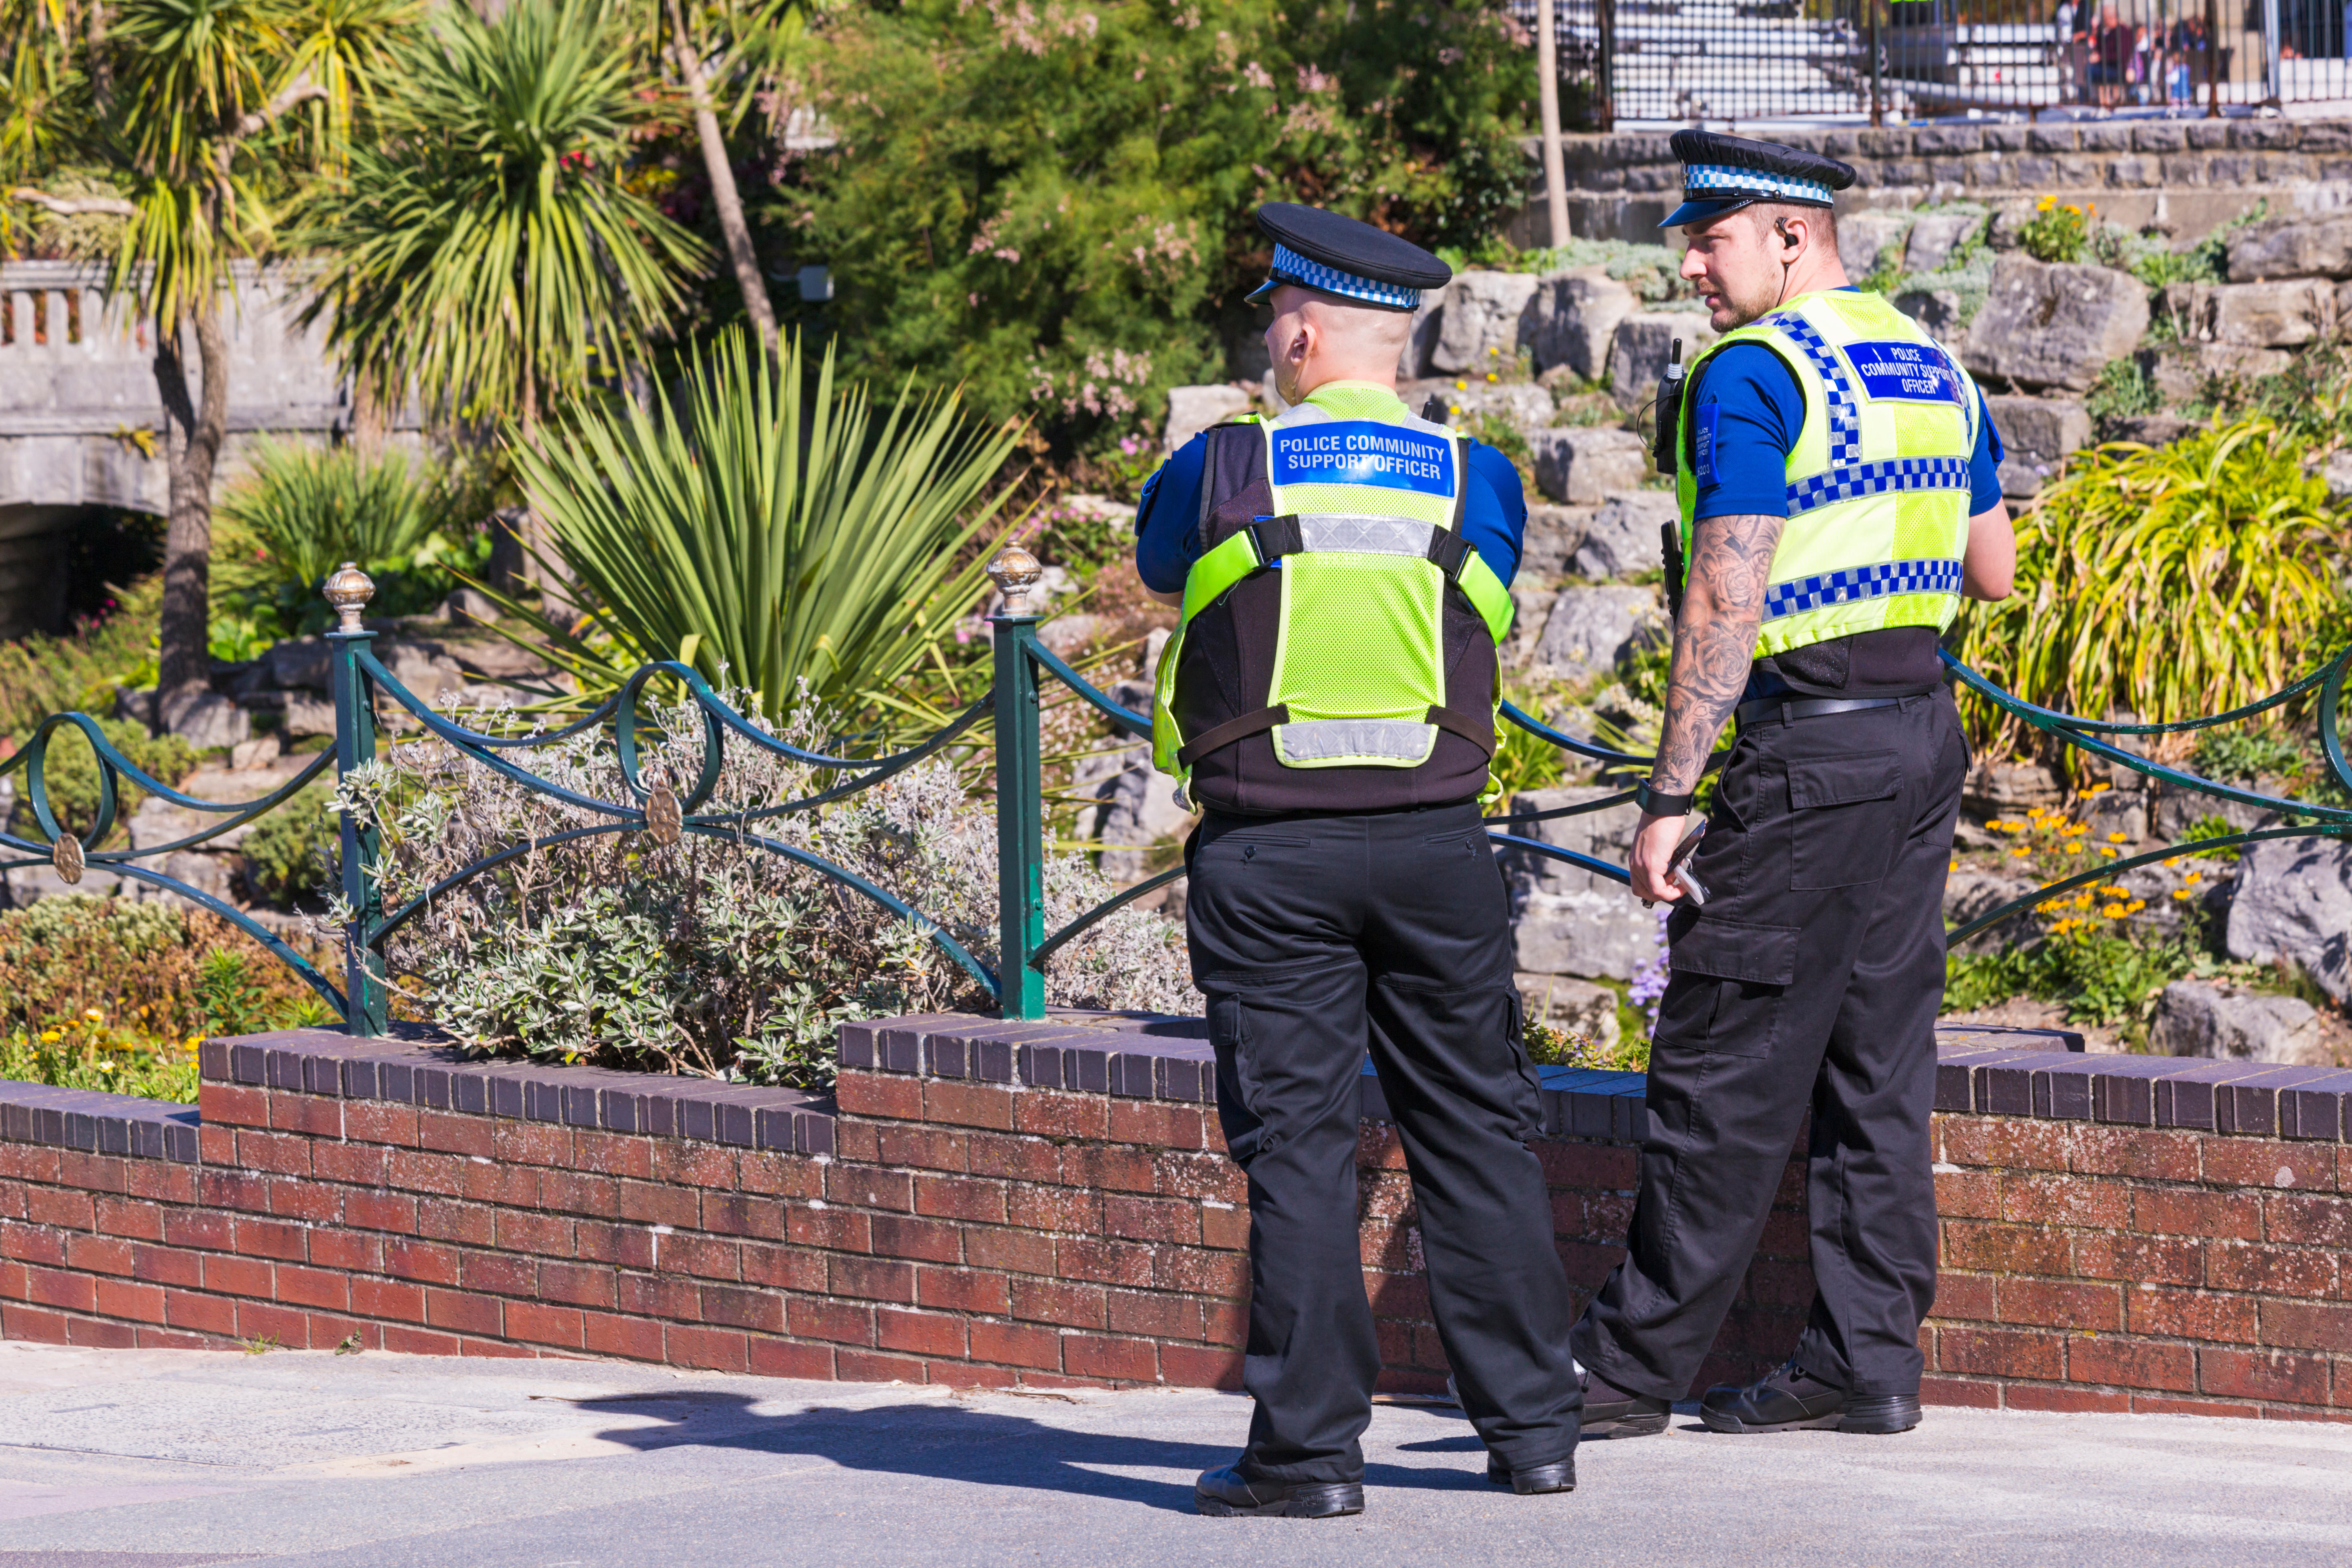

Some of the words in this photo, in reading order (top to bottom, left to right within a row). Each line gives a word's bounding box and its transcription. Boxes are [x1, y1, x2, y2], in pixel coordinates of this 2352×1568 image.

[1891, 347, 1922, 362] POLICE
[1861, 362, 1919, 377] COMMUNITY
[1921, 364, 1953, 382] SUPPORT
[1902, 378, 1936, 394] OFFICER
[1280, 436, 1340, 452] POLICE
[1346, 435, 1444, 462] COMMUNITY
[1288, 454, 1370, 470] SUPPORT
[1374, 454, 1441, 480] OFFICER
